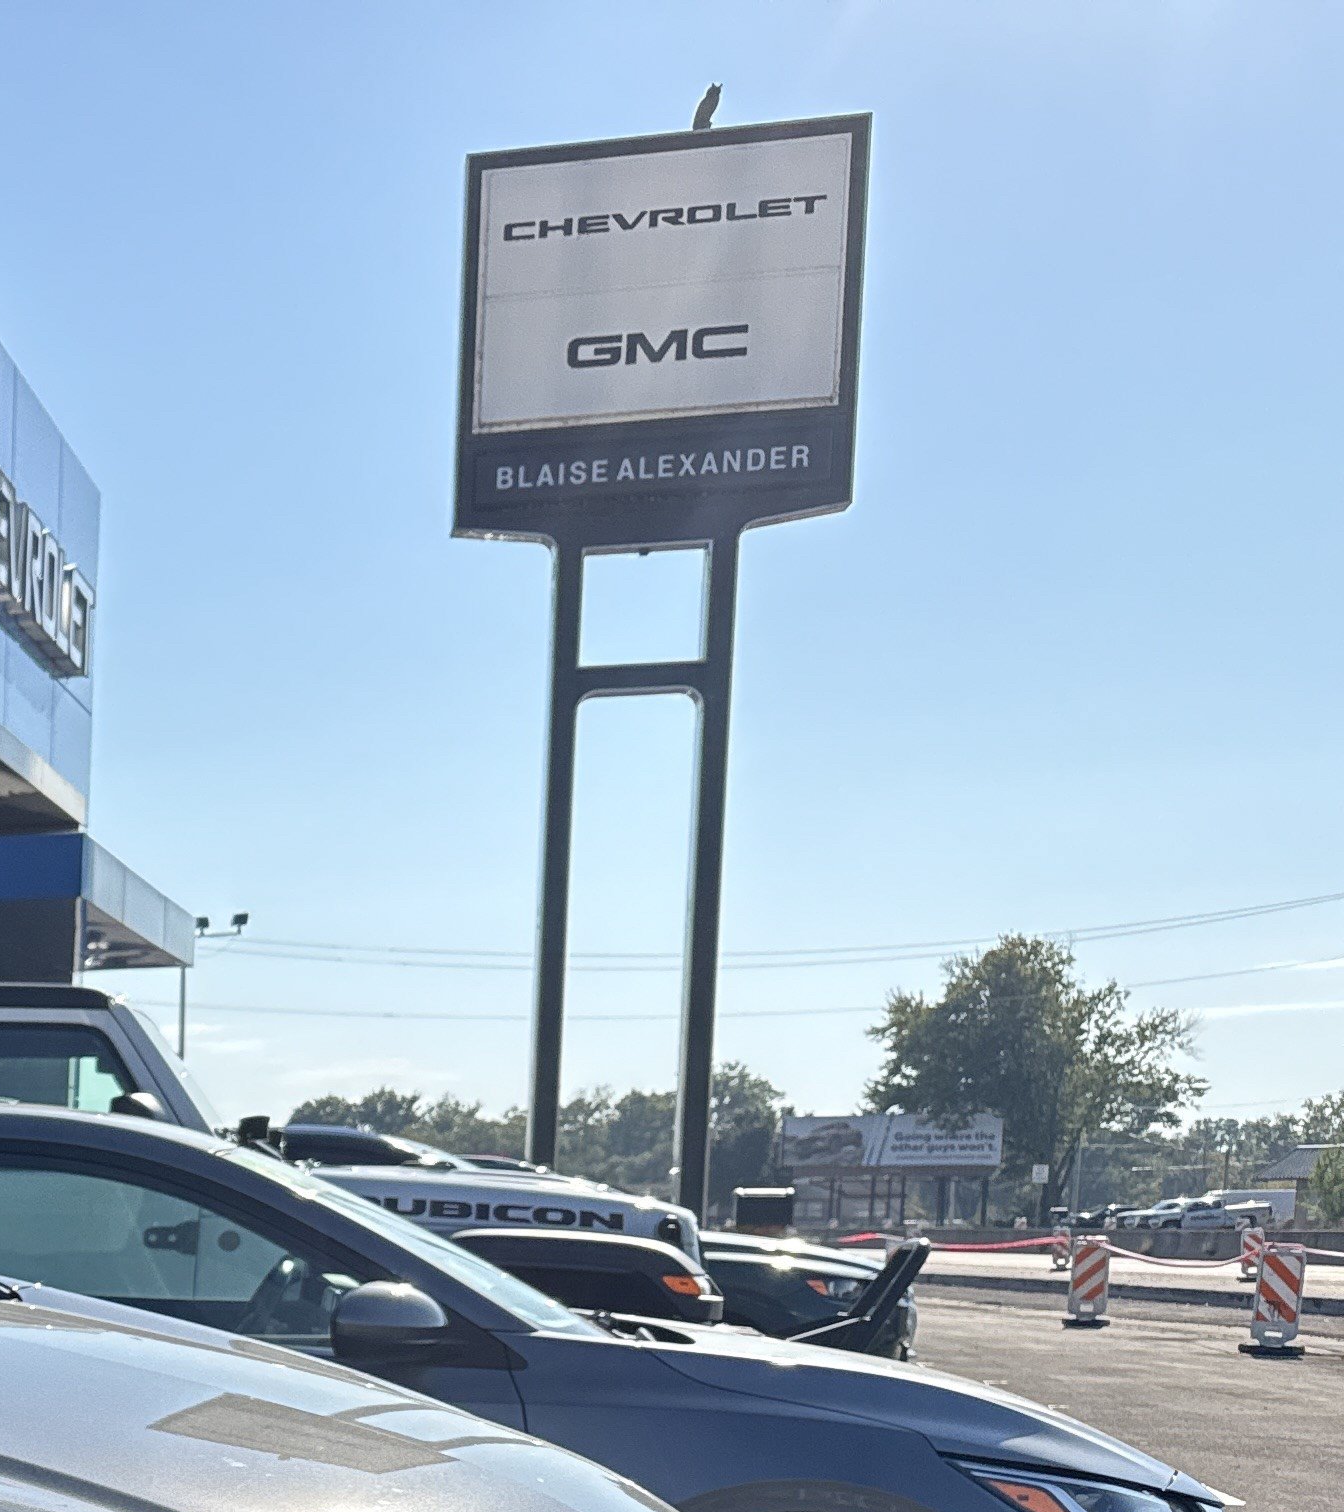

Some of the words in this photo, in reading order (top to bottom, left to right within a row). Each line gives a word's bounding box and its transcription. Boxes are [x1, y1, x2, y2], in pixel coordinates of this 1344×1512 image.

[502, 195, 828, 242] CHEVROLET
[566, 324, 750, 370] GMC
[495, 457, 609, 491] BLAISE
[615, 444, 811, 481] ALEXANDER
[364, 1195, 625, 1231] UBICON
